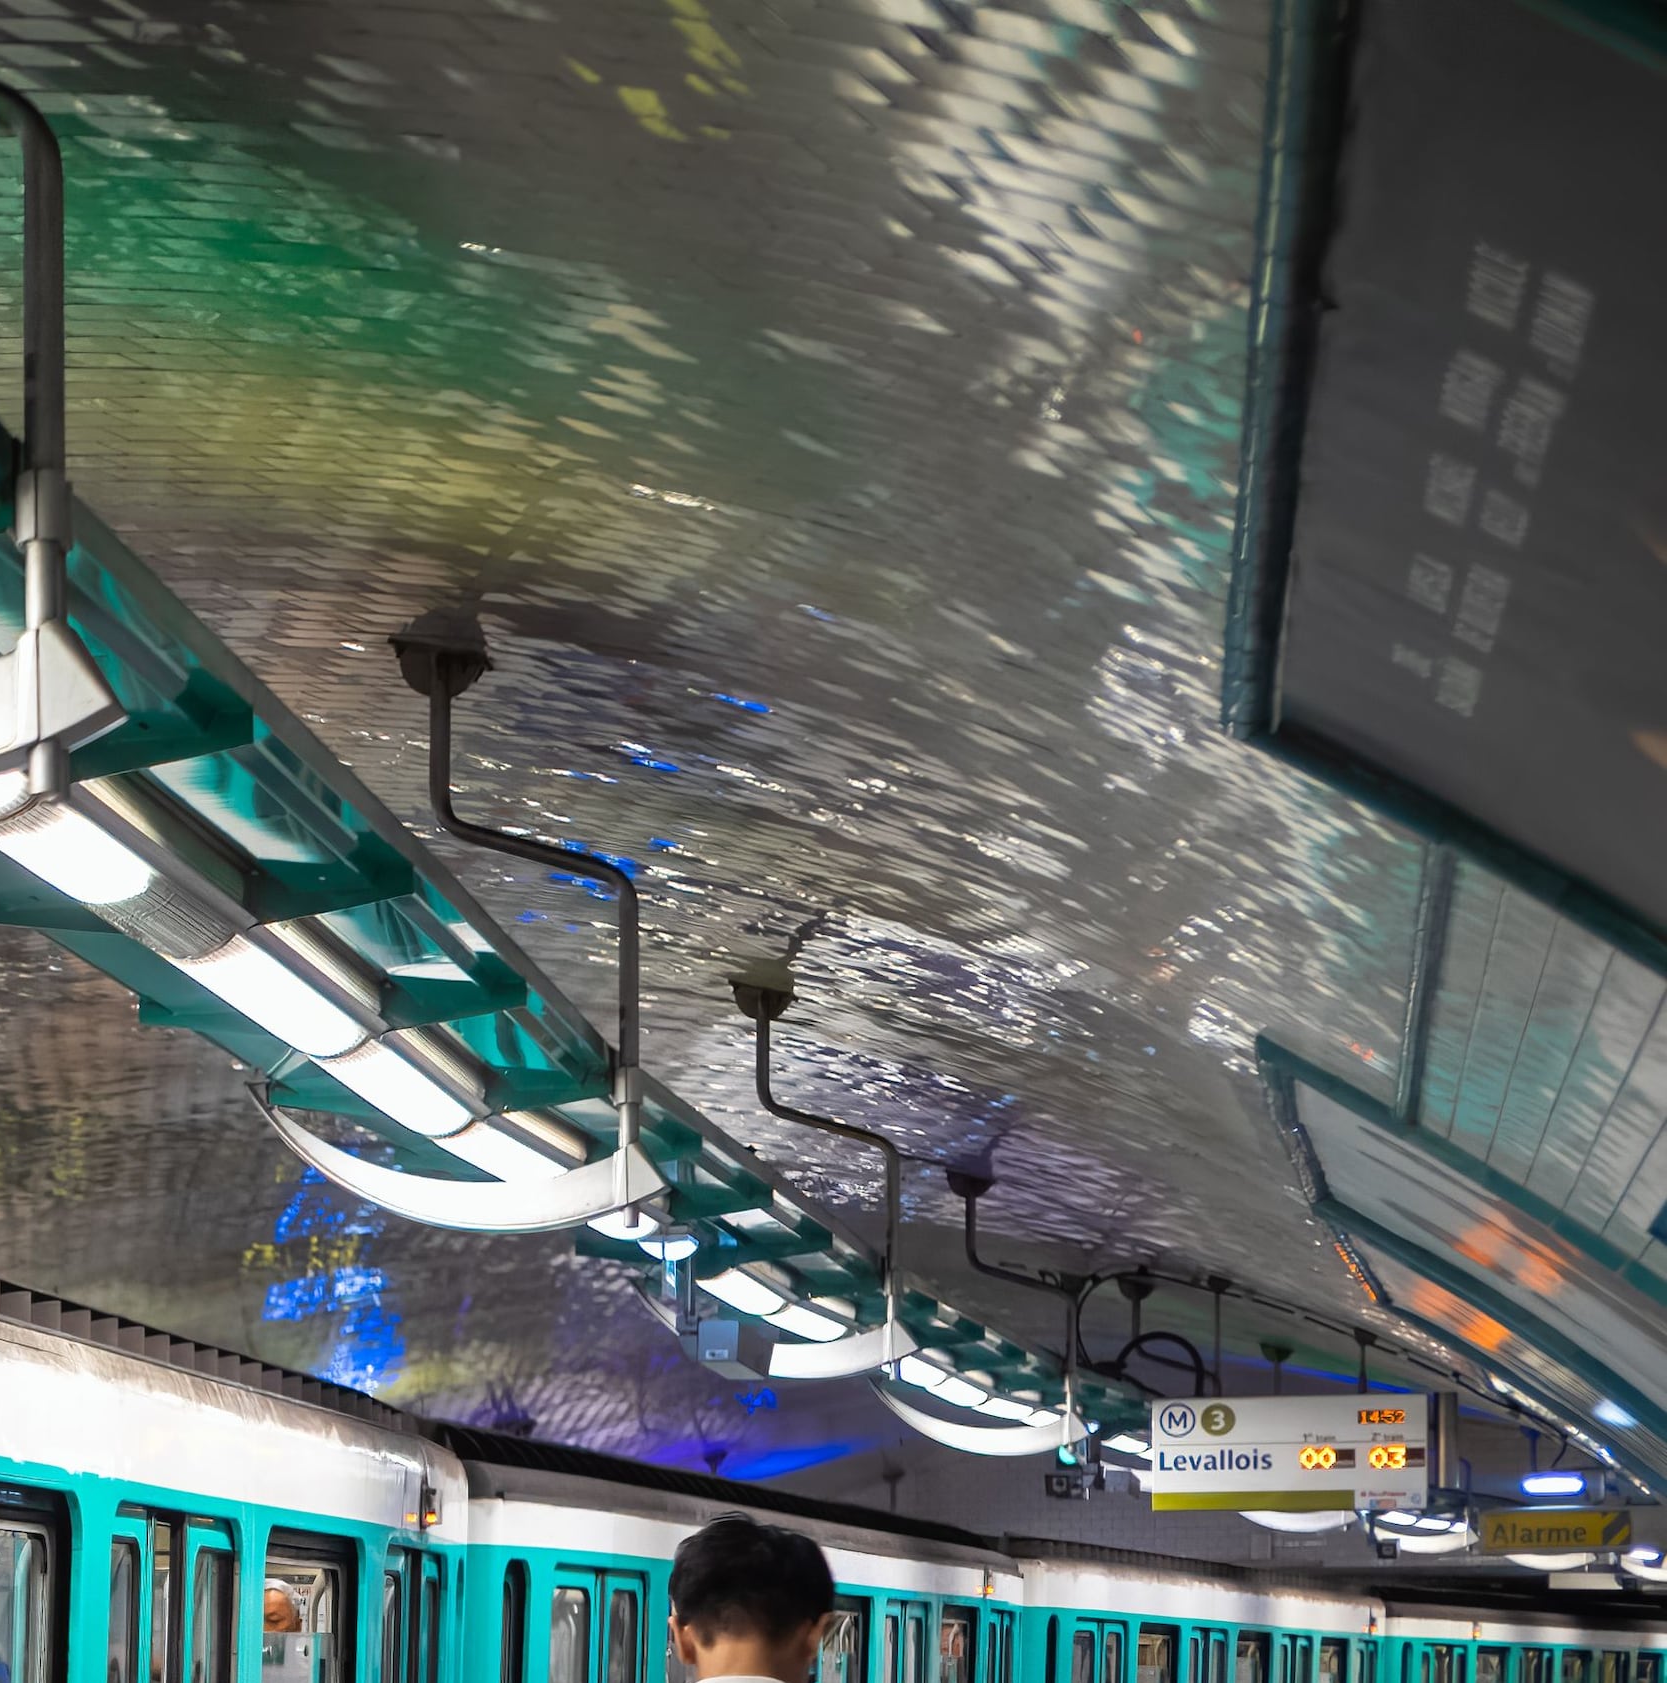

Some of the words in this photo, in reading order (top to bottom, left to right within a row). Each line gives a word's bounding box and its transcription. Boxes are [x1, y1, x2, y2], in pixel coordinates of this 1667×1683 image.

[1210, 1410, 1226, 1431] 3
[1159, 1450, 1273, 1472] Levallois
[1298, 1444, 1337, 1470] 00
[1368, 1443, 1407, 1470] 03
[1493, 1522, 1587, 1545] Alarme
